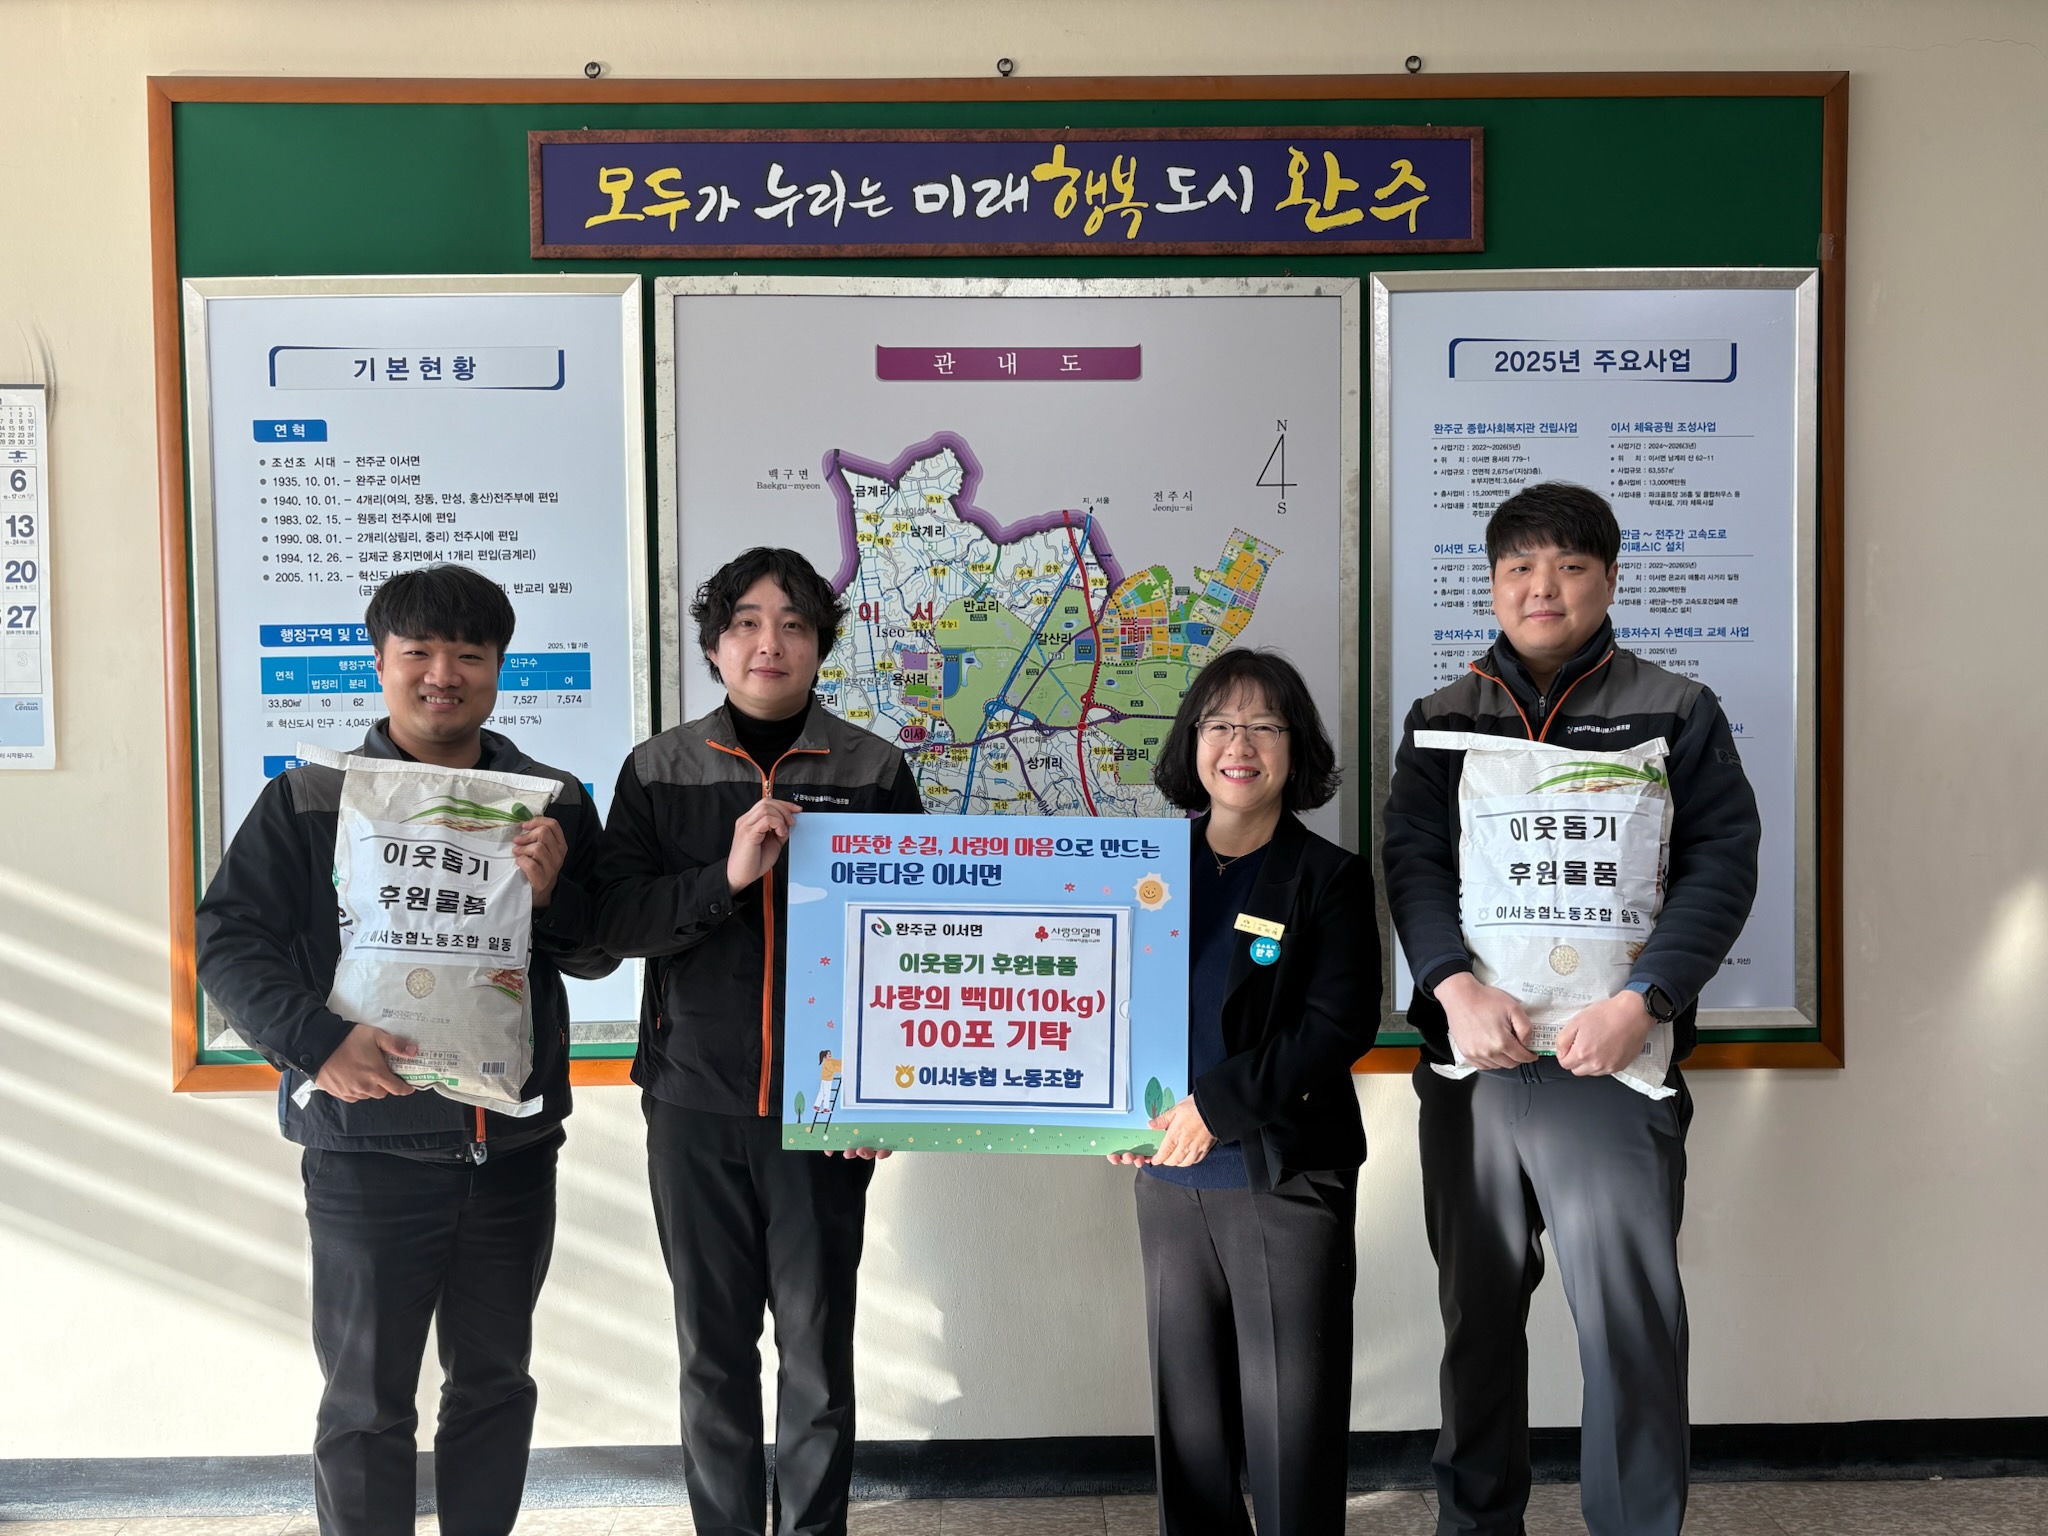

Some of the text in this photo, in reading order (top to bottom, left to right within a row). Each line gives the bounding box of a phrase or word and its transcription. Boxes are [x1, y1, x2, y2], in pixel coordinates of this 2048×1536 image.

[585, 167, 741, 232] 모두가
[754, 163, 893, 228] 누리는
[1275, 146, 1430, 234] 완주
[1494, 348, 1692, 373] 2025년 주요사업
[353, 356, 477, 382] 기본현황
[273, 423, 306, 438] 연혁
[1277, 419, 1288, 432] N
[1433, 422, 1578, 435] 완주군 종합사회복지관 건립사업
[1611, 421, 1717, 433] 이서 체육공원 조성사업
[1617, 442, 1642, 450] 사업기간
[271, 455, 421, 468] 조선조 시대 전주군 이서면
[1648, 454, 1686, 462] 이서면 남계리
[1440, 468, 1465, 476] 사업규모
[10, 469, 27, 493] 6
[273, 474, 421, 487] 1935. 10. 01. 완주군 이서면
[756, 482, 821, 491] Baekgu-myeon
[855, 485, 891, 498] 금계리
[1153, 490, 1193, 503] 전주시
[273, 495, 301, 506] 1940.
[306, 495, 321, 506] 10.
[324, 495, 341, 506] 01.
[414, 493, 438, 505] 장동,
[441, 493, 465, 505] 만성,
[538, 491, 559, 503] 편입
[1152, 503, 1193, 513] Jeonju-si
[1277, 502, 1287, 514] S
[274, 512, 456, 525] 1983. 02. 15. 원동리 전주시에 편입
[5, 514, 35, 538] 13
[910, 525, 946, 539] 남계리
[274, 534, 302, 544] 1990.
[306, 534, 322, 544] 08.
[326, 534, 342, 544] 01.
[425, 531, 450, 543] 중리)
[453, 531, 494, 542] 전주시에
[498, 530, 518, 542] 편입
[1620, 528, 1727, 540] 만금 전주간 고속도로
[1434, 544, 1464, 555] 이서면
[1620, 541, 1685, 552] 이패스IC 설치
[275, 549, 536, 563] 1994. 12. 26. 김제군 용지면에서 1개리 편입(금계리)
[5, 560, 37, 583] 20
[275, 571, 343, 582] 2005. 11. 23.
[514, 582, 573, 594] 반교리 일원)
[963, 600, 999, 613] 반교리
[7, 605, 37, 628] 27
[280, 628, 332, 643] 행정구역
[337, 628, 350, 642] 및
[1433, 629, 1484, 641] 광석저수지
[1664, 627, 1703, 638] 수변데크
[1706, 627, 1727, 638] 교체
[1730, 626, 1749, 637] 사업
[1036, 632, 1073, 646] 갈산리
[338, 660, 376, 671] 행정구역
[510, 658, 538, 668] 인구수
[275, 670, 294, 681] 면적
[520, 676, 530, 687] 남
[564, 676, 574, 686] 여
[893, 673, 928, 686] 용서리
[311, 679, 338, 690] 법정리
[348, 679, 367, 690] 분리
[321, 698, 331, 707] 10
[353, 698, 364, 707] 62
[512, 695, 538, 706] 7,527
[557, 695, 582, 705] 7,574
[278, 718, 335, 729] 혁신도시 인구
[499, 714, 542, 726] 대비 57%)
[904, 729, 923, 741] 이서
[1113, 748, 1149, 761] 금평리
[1027, 757, 1062, 770] 상개리
[1509, 815, 1617, 842] 이웃돕기
[832, 835, 1160, 859] 따뜻한 손길, 사랑의 마음으로 만드는
[383, 842, 489, 881] 이웃돕기
[831, 862, 1002, 887] 아름다운 이서면
[1508, 860, 1618, 887] 후원물품
[378, 884, 487, 916] 후원물품
[1496, 906, 1640, 924] 이서농협노동조합 일동
[896, 922, 983, 937] 완주군 이서면
[1051, 926, 1101, 939] 사랑의열매
[369, 930, 512, 952] 이서농협노동조합 일동
[899, 953, 1078, 977] 이웃돕기 후원물품
[870, 985, 1105, 1018] 사랑의 백미(10kg)
[900, 1019, 1072, 1051] 100포 기탁
[919, 1066, 1084, 1089] 이서농협 노동조합
